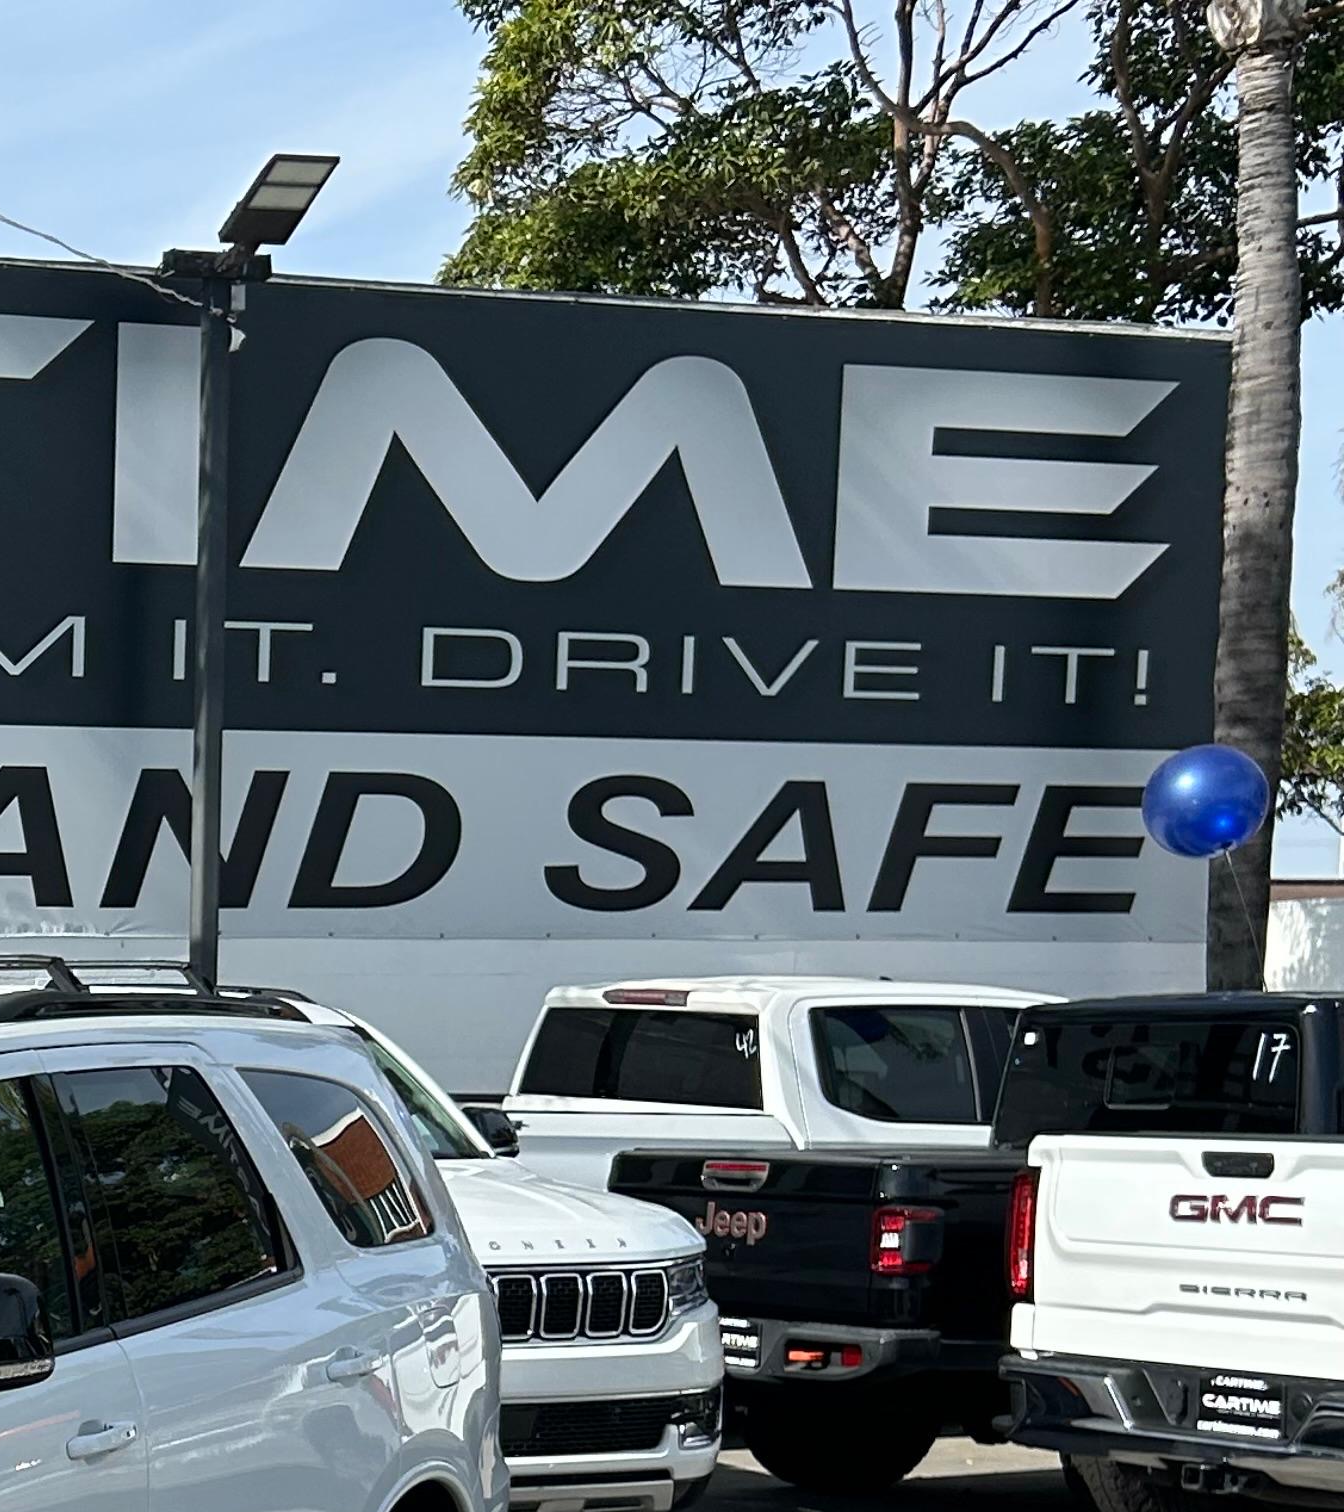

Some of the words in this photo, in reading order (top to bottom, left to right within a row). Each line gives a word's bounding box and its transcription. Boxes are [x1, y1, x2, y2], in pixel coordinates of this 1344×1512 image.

[173, 619, 337, 684] IT.
[421, 627, 921, 700] DRIVE
[992, 645, 1149, 705] IT!
[543, 775, 1147, 914] SAFE
[1252, 1031, 1292, 1083] 17
[695, 1200, 768, 1245] Jeep
[1168, 1193, 1307, 1227] GMC
[1178, 1283, 1308, 1302] SIERRA
[1202, 1393, 1281, 1415] CARTIME
